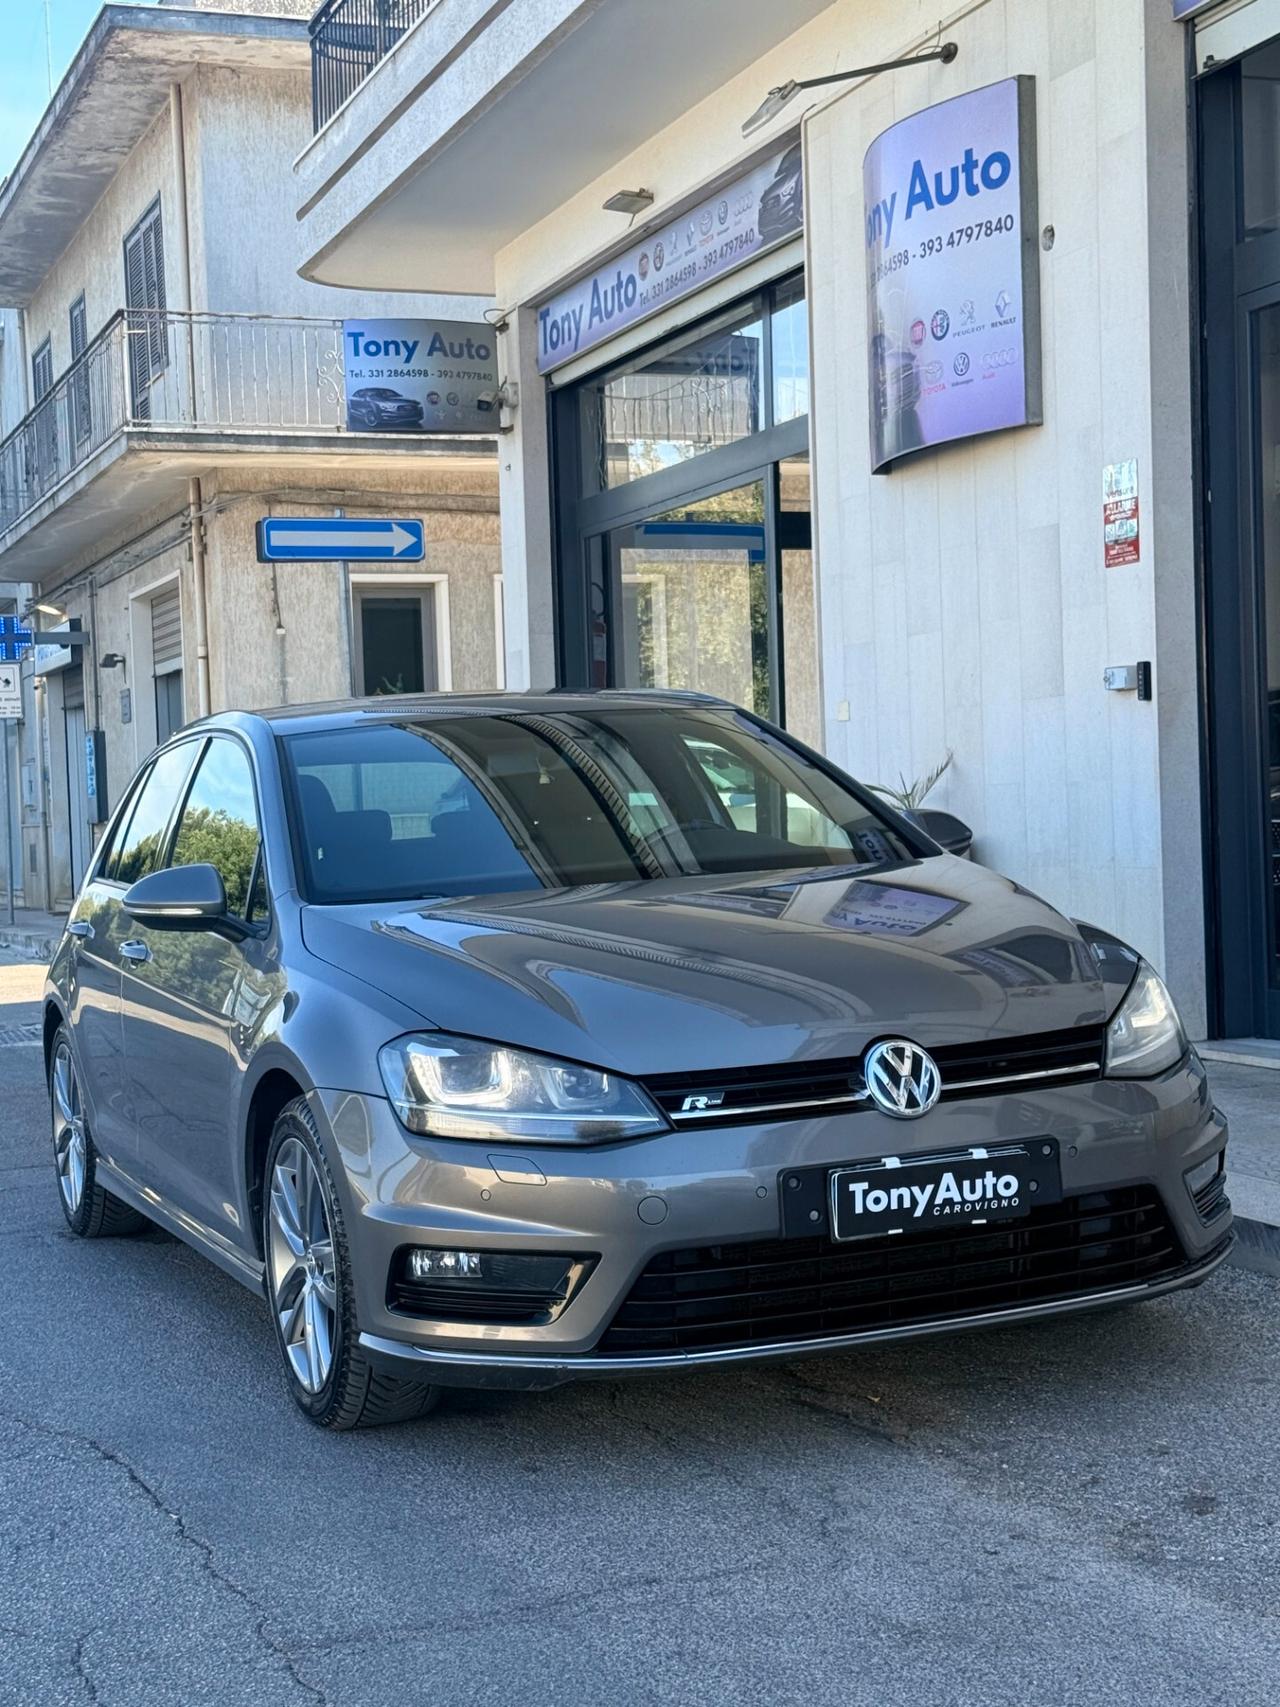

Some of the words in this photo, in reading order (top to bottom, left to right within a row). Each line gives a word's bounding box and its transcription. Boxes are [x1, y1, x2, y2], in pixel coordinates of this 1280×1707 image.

[866, 191, 897, 249] ony
[904, 147, 1011, 221] Auto
[919, 235, 943, 259] 393
[946, 214, 1014, 249] 4797840
[651, 282, 664, 300] 331
[664, 261, 697, 291] 2864598
[703, 248, 717, 271] 393
[719, 228, 755, 260] 4797840
[539, 302, 584, 355] Tony
[587, 270, 637, 330] Auto
[347, 331, 420, 364] Tony
[427, 331, 491, 361] Auto
[349, 369, 365, 378] Tel.
[368, 369, 384, 377] 331
[387, 369, 429, 378] 2864598
[437, 369, 454, 378] 393
[456, 371, 493, 381] 4797840
[849, 1170, 1019, 1218] TonyAuto
[933, 1197, 1020, 1216] CAROVIGNO
